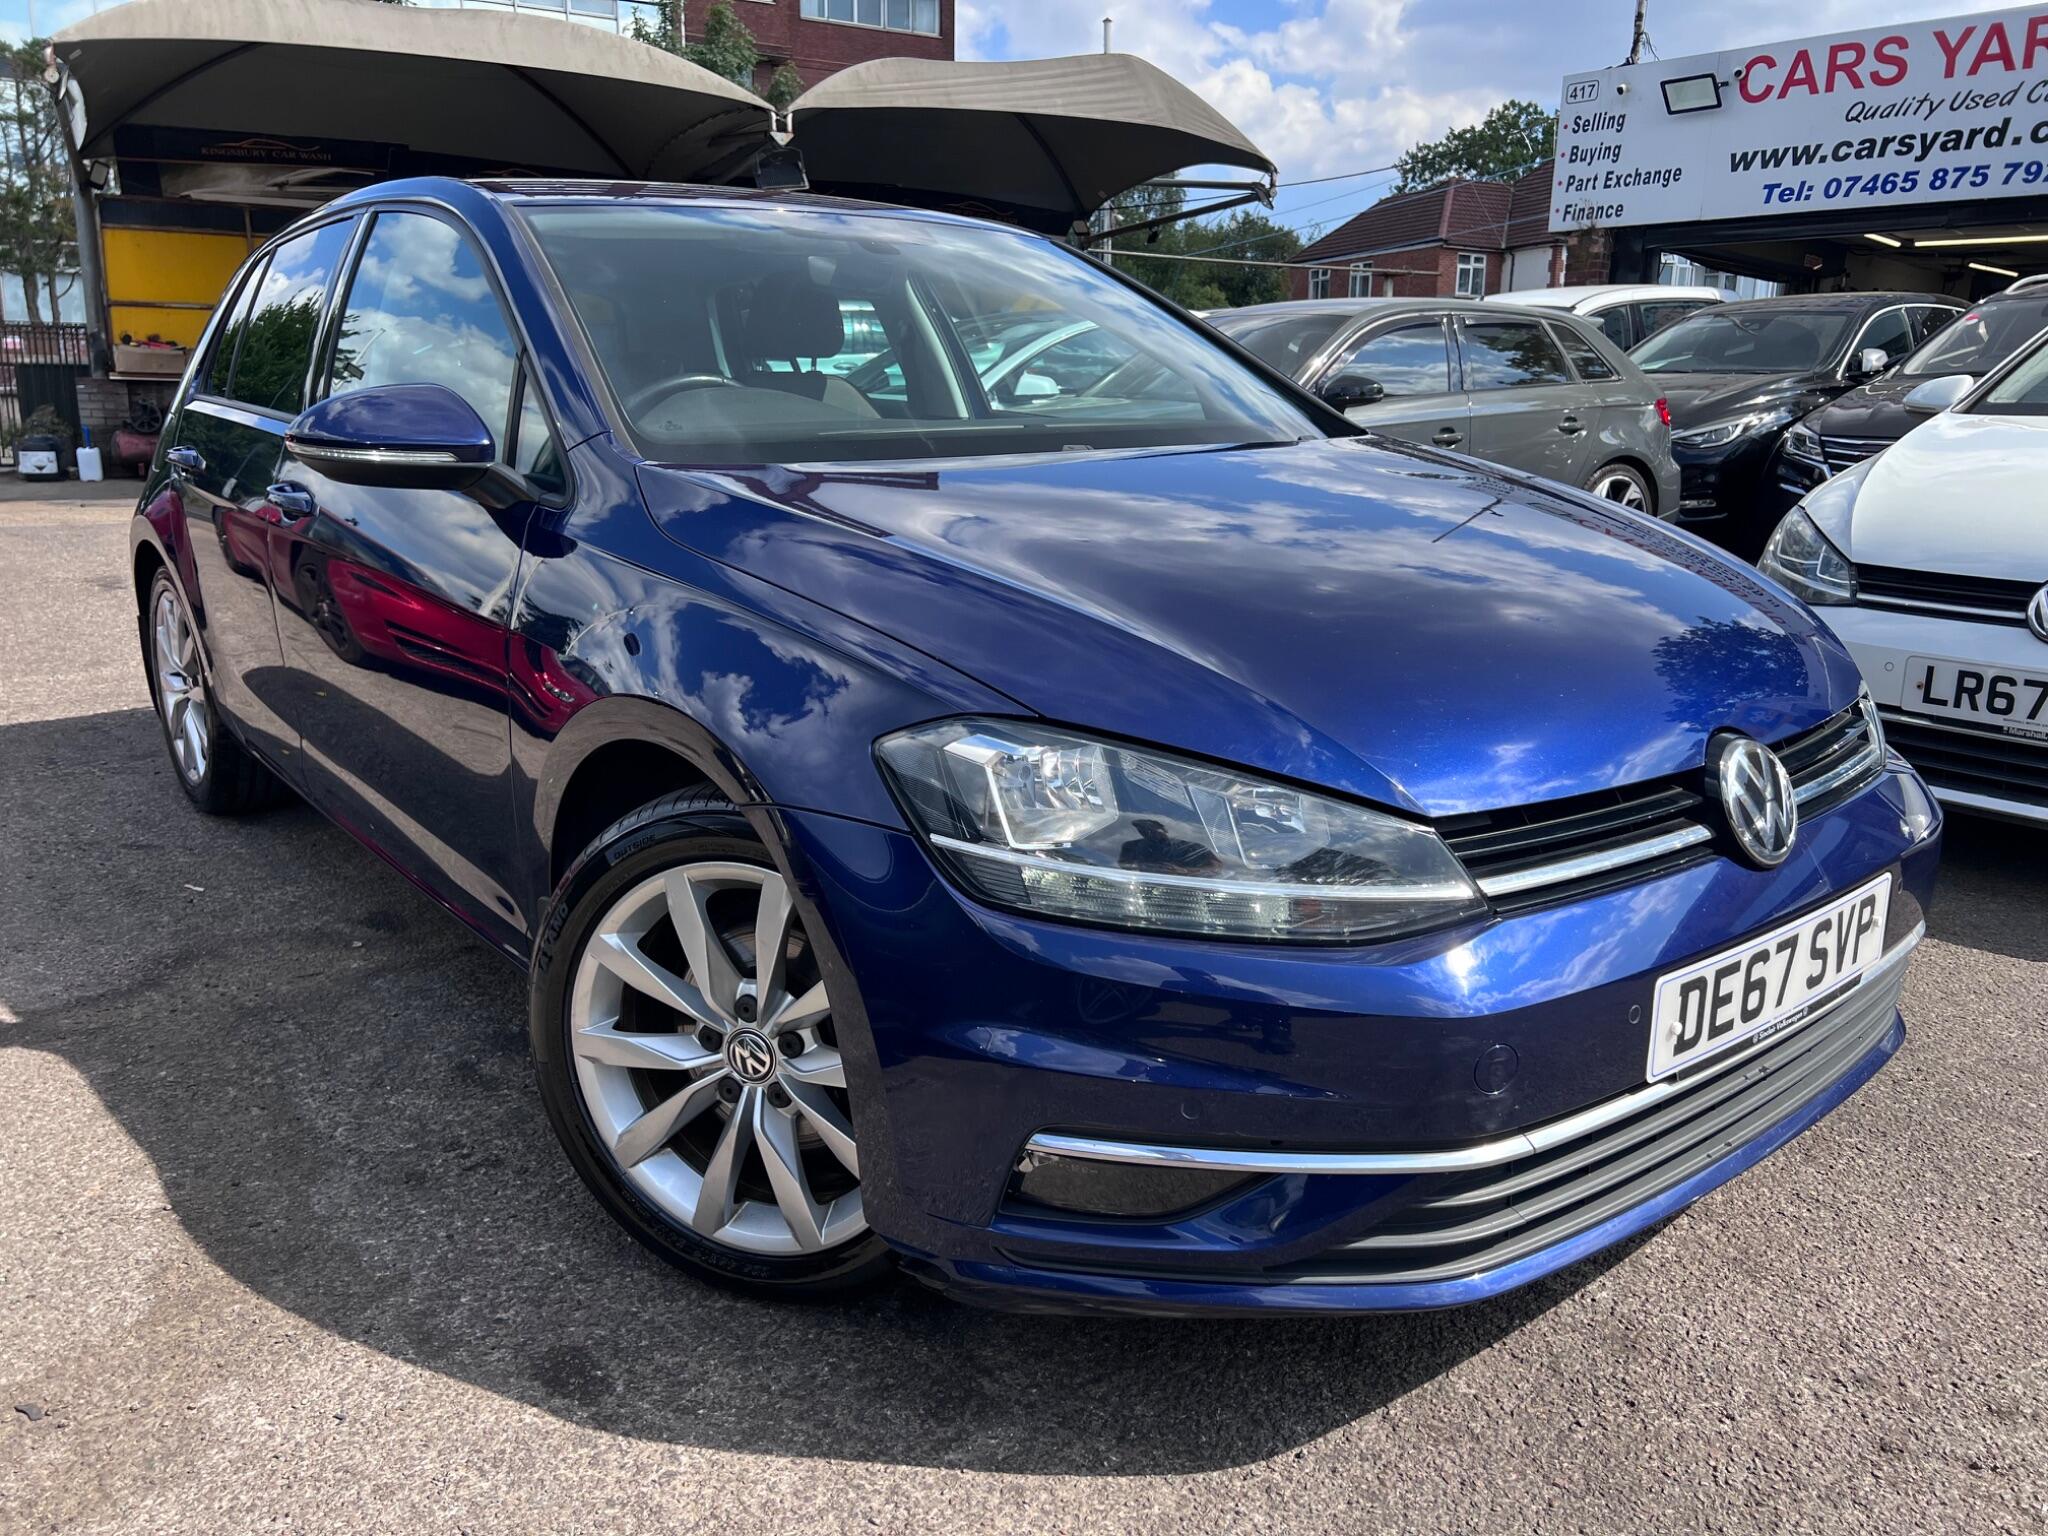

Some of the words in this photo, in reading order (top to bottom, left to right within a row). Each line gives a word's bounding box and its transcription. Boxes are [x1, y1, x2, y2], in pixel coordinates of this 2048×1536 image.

[1739, 36, 1909, 104] CARS
[1570, 84, 1596, 101] 417
[1845, 92, 1945, 123] Quality
[1949, 81, 2025, 112] Used
[1572, 112, 1626, 134] Selling
[201, 147, 267, 158] KINGSBURY
[272, 151, 297, 159] CAR
[299, 151, 332, 161] WASH
[1568, 142, 1622, 166] Buying
[1565, 173, 1599, 193] Part
[1603, 167, 1682, 189] Exchange
[1762, 181, 1814, 204] Tel:
[1823, 170, 1920, 199] 07465
[1929, 165, 1990, 190] 875
[1562, 202, 1624, 222] Finance
[1922, 665, 2048, 721] LR67
[1672, 932, 1799, 1057] DE67
[1806, 893, 1877, 990] SVP
